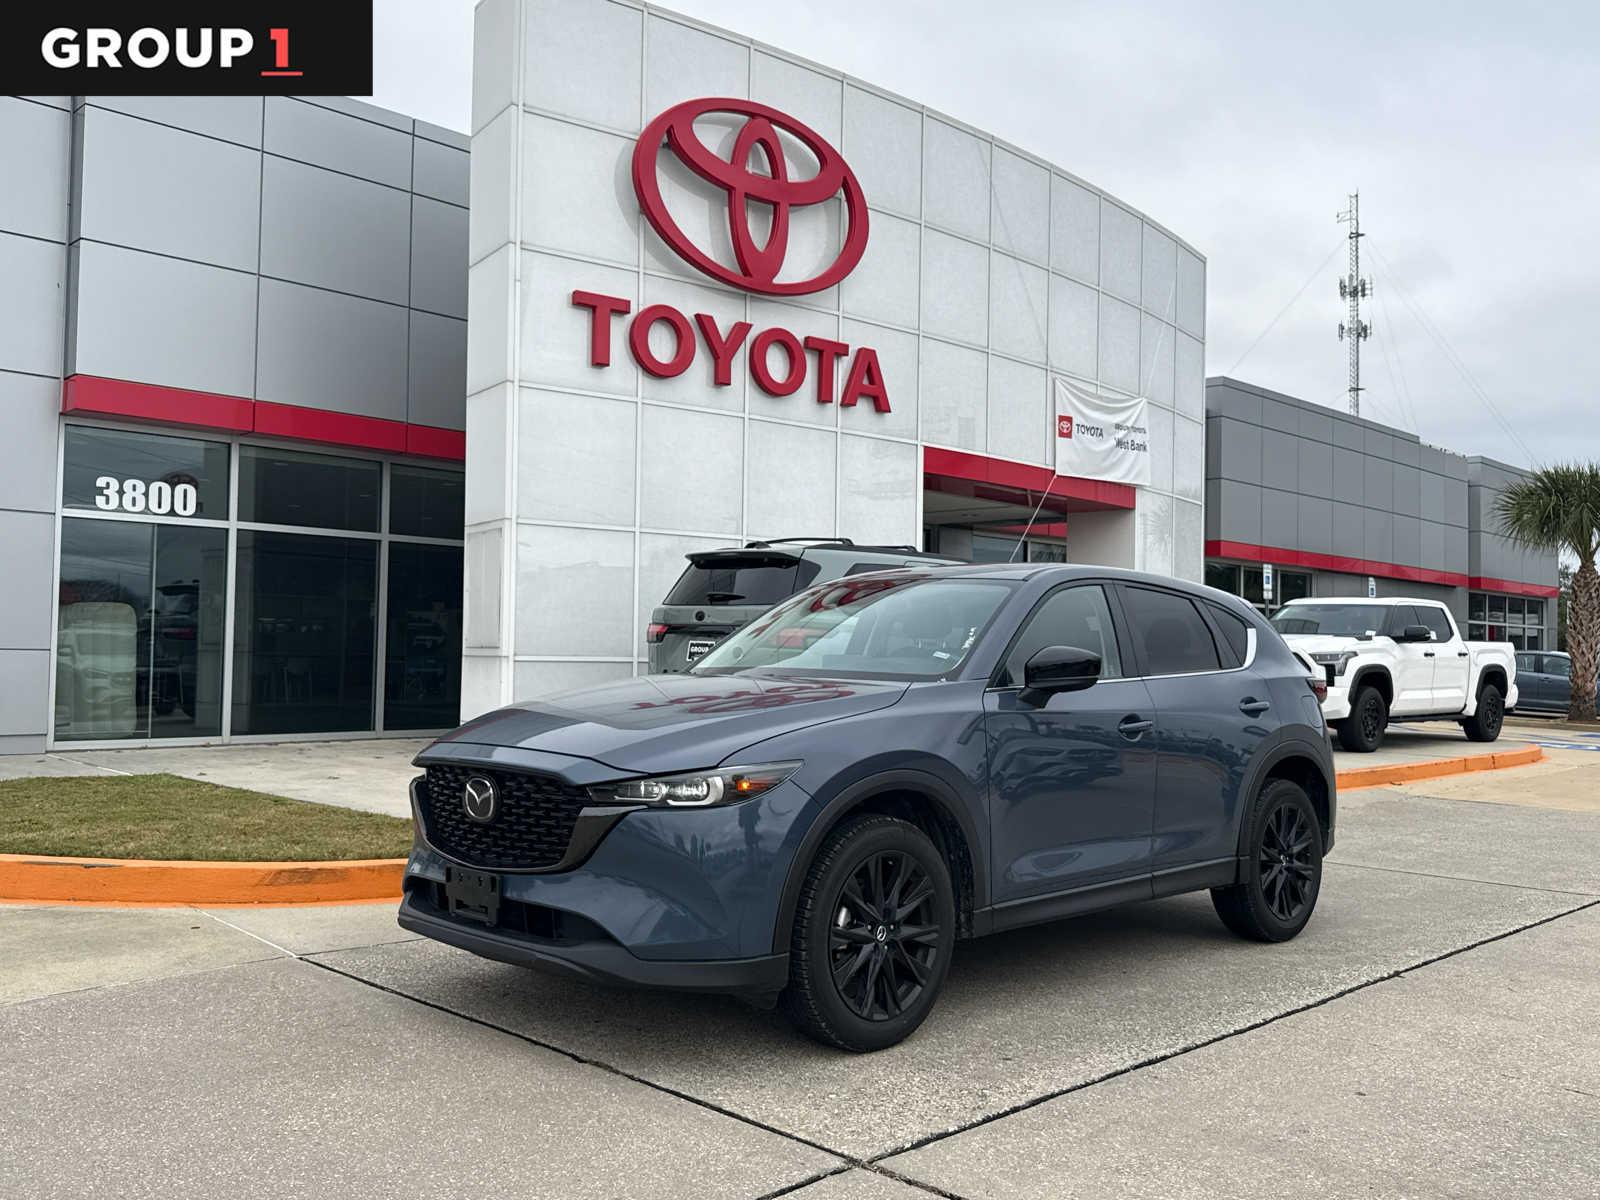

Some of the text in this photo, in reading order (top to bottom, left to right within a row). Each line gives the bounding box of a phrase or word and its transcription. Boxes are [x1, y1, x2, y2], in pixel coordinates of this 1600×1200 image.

[572, 291, 892, 413] TOYOTA
[1076, 424, 1104, 439] TOYOTA
[1131, 439, 1148, 452] Bank
[96, 476, 197, 516] 3800
